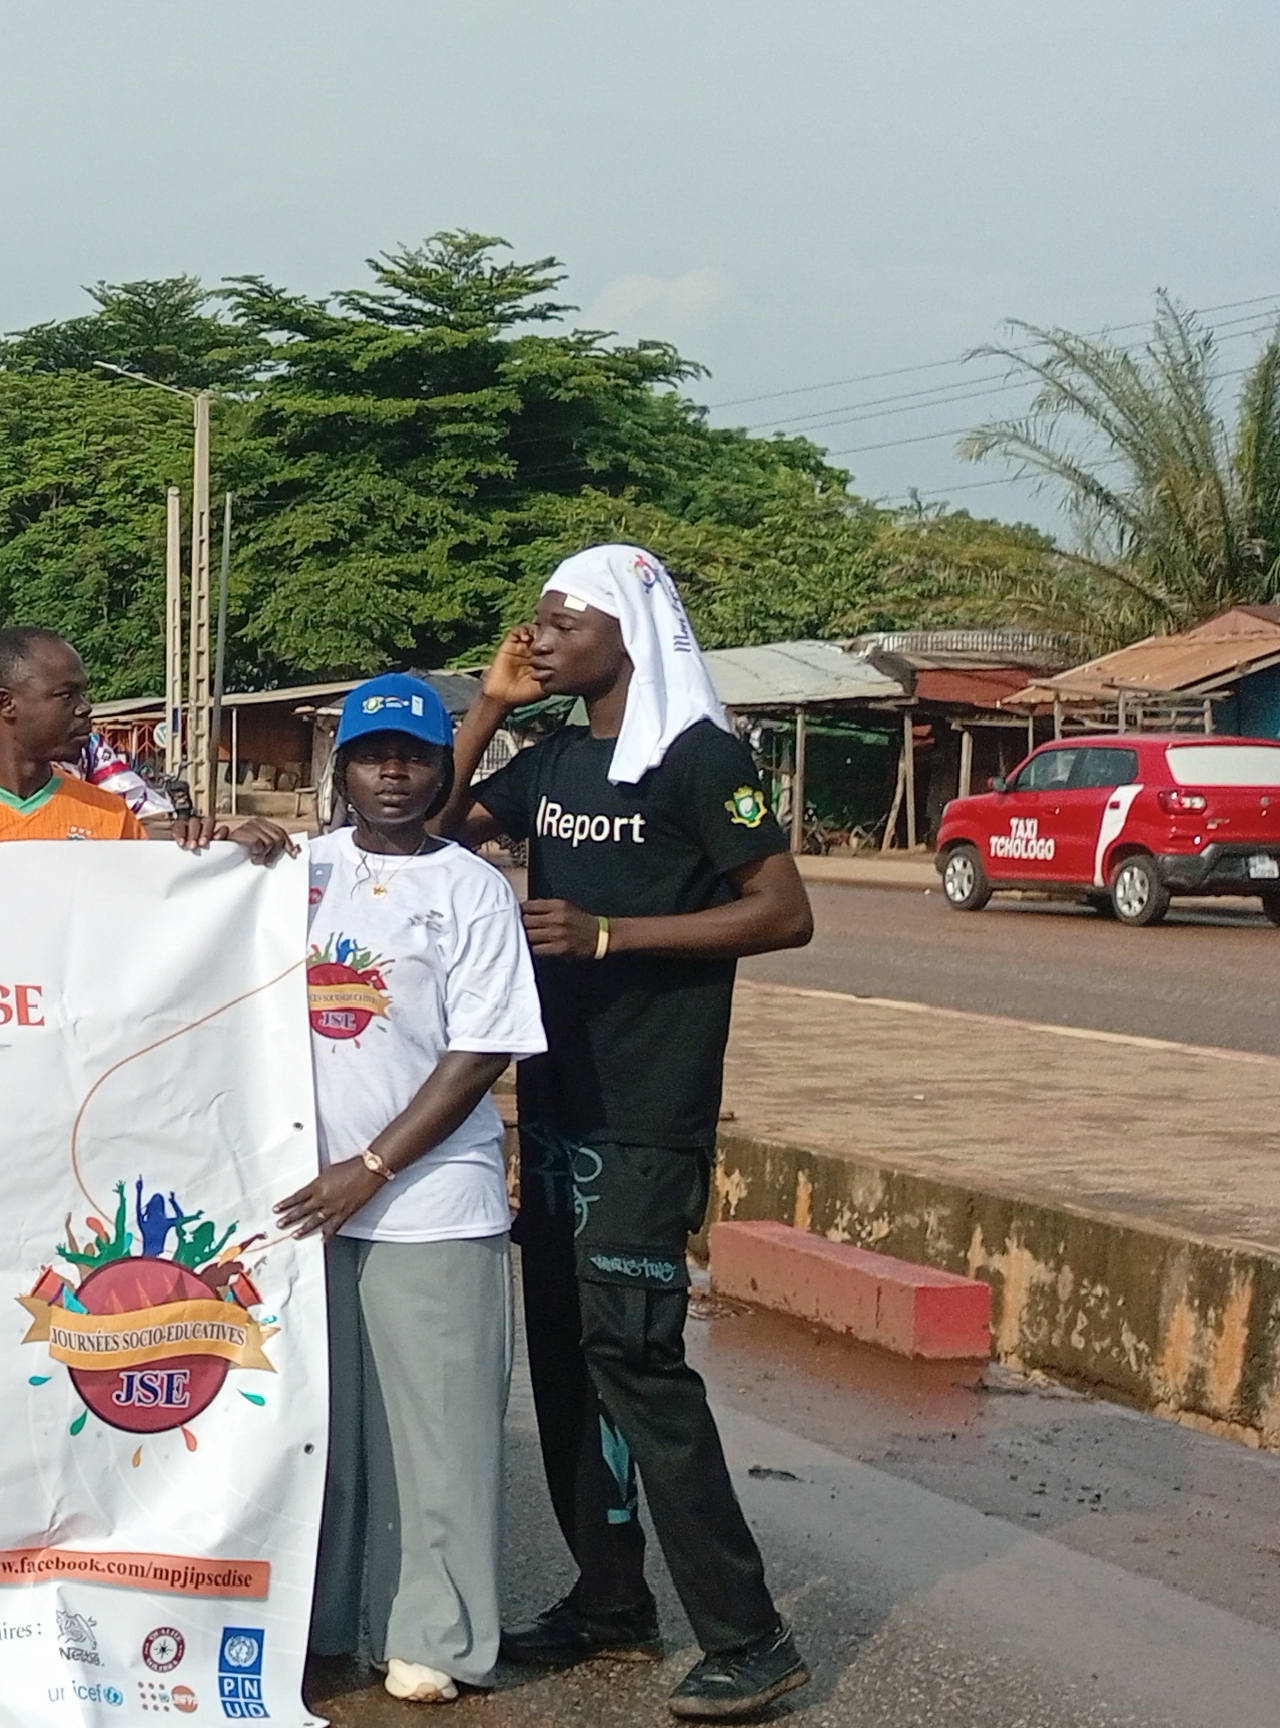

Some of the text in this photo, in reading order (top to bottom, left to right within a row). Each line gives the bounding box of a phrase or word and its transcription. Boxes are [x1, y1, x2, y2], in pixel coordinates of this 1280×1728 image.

[1010, 817, 1038, 839] TAXI
[990, 836, 1055, 860] TCHOLOGO
[52, 1323, 245, 1352] JOURNÉES SOCIO-EDUCATIVES
[115, 1372, 188, 1406] JSE
